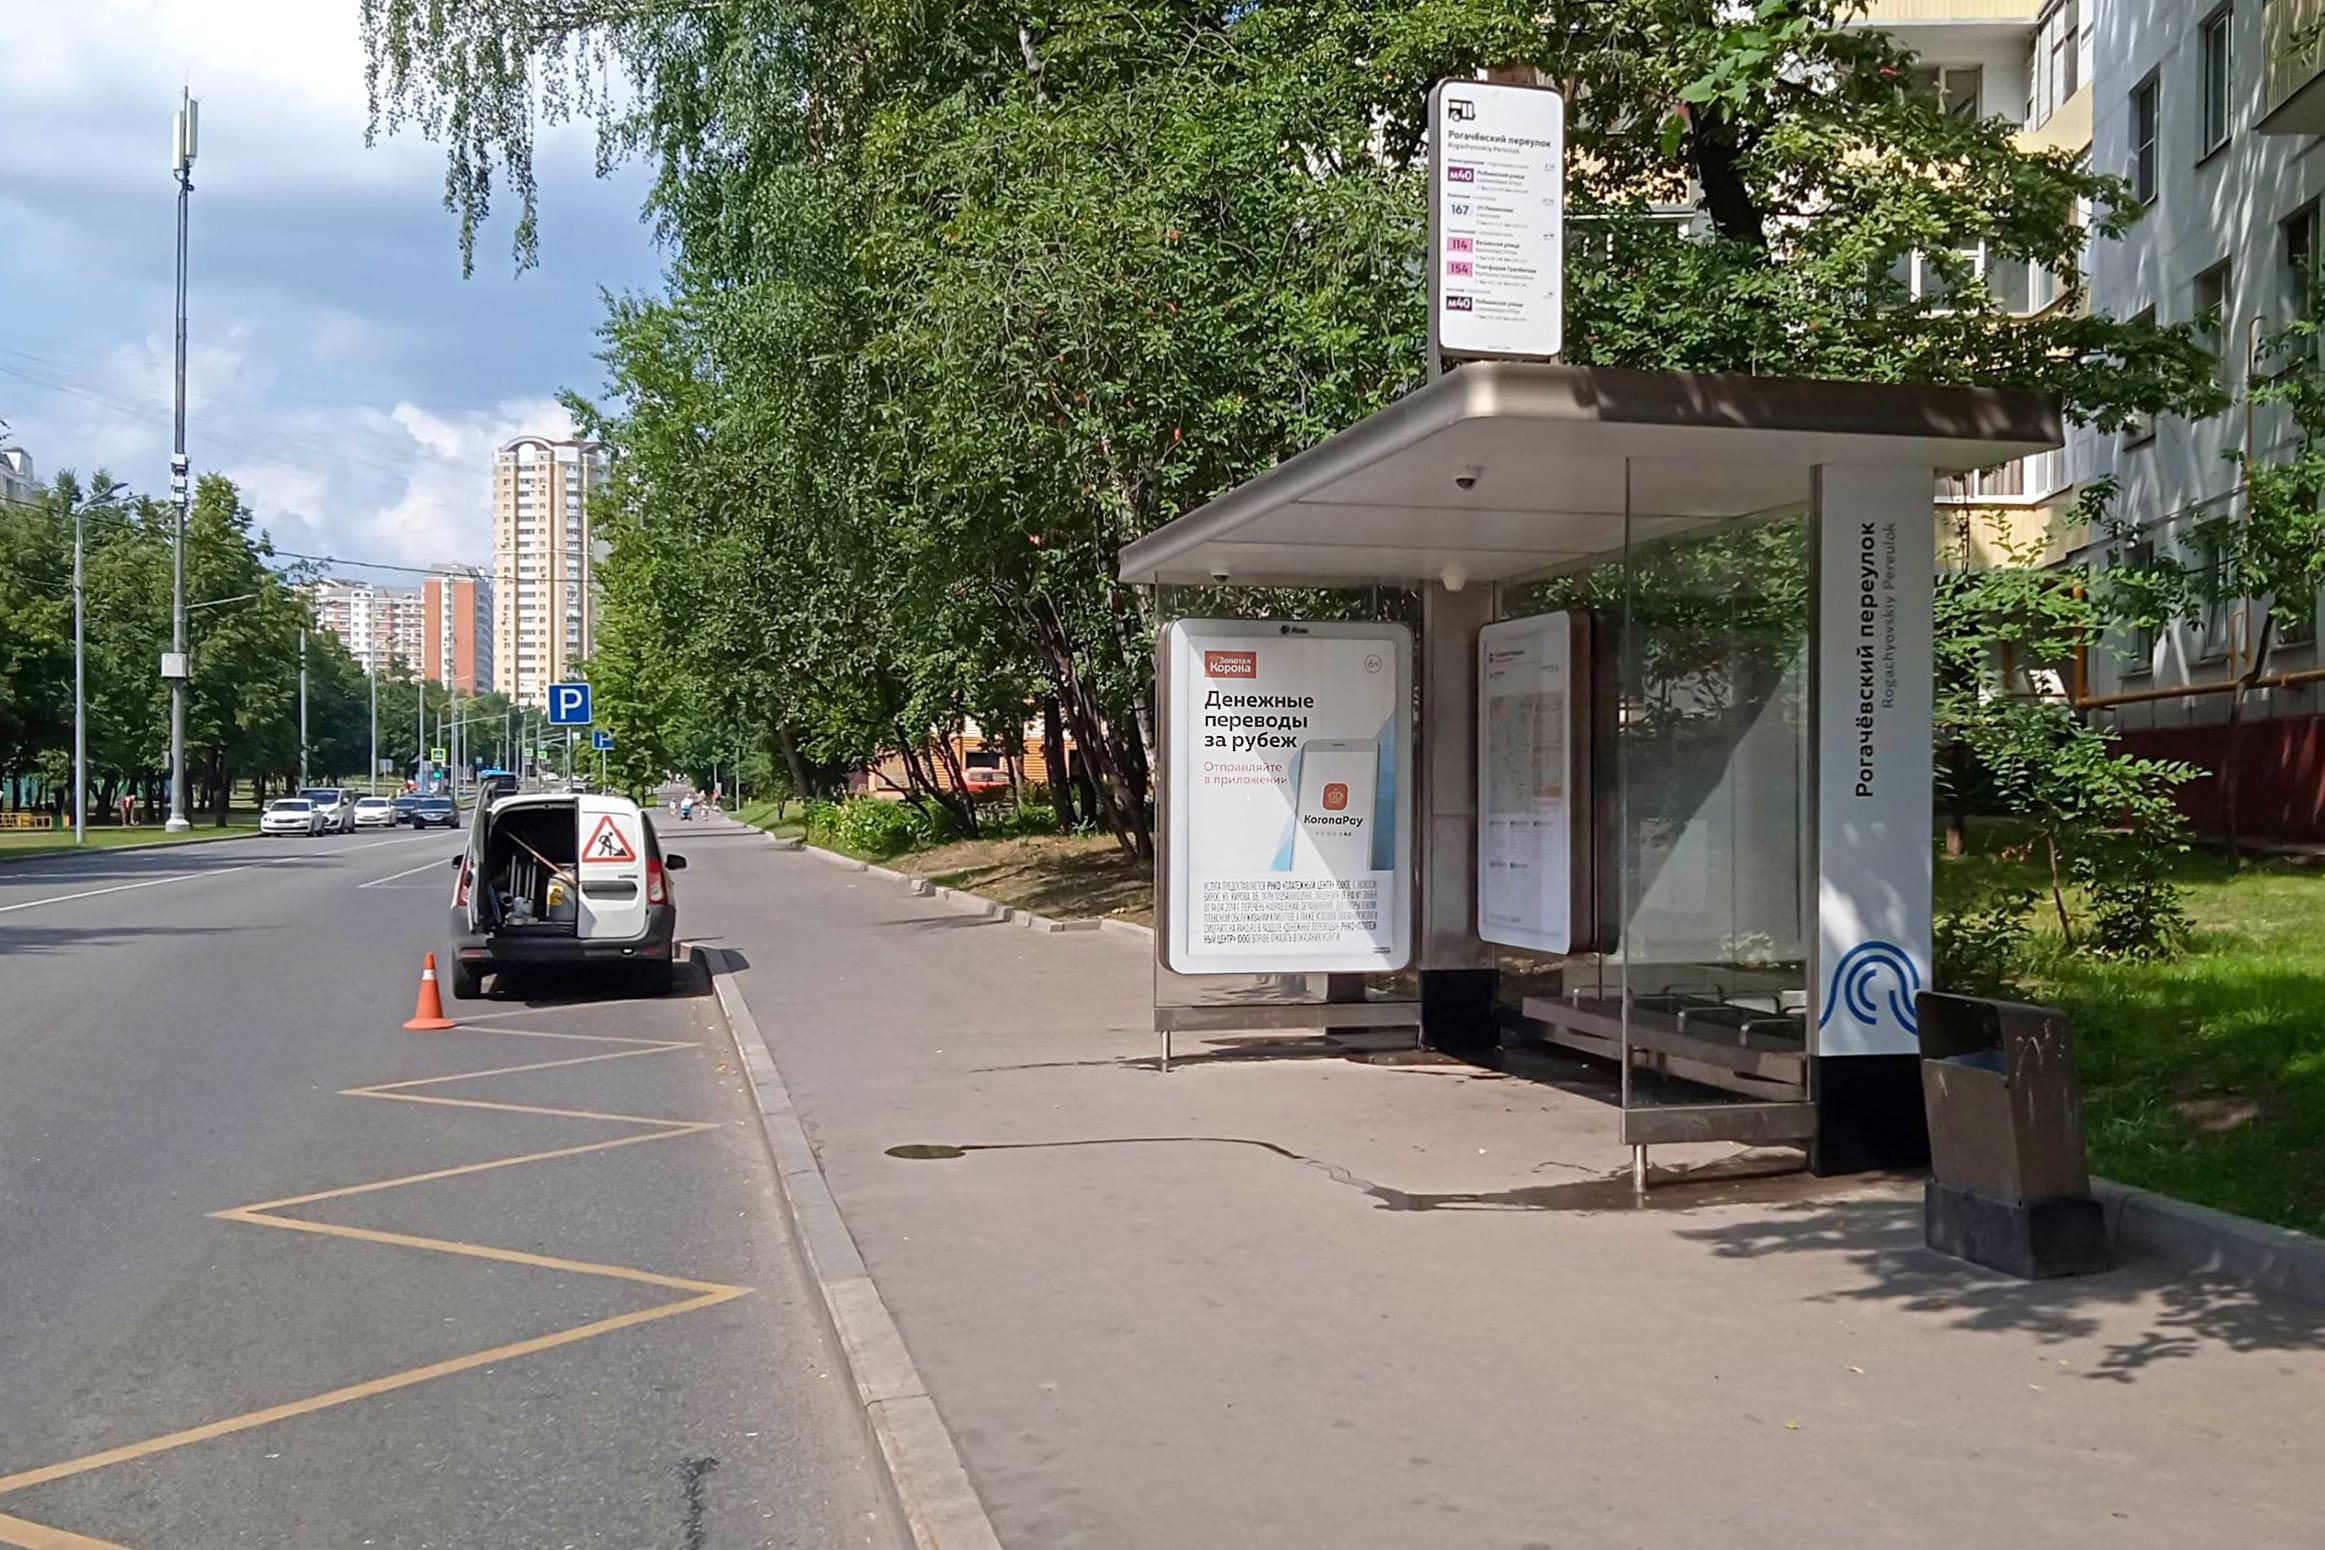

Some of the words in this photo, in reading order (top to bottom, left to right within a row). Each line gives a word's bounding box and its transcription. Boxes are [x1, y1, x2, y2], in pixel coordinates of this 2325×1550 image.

[1508, 137, 1551, 149] переулок
[1449, 169, 1472, 181] м40
[1451, 204, 1470, 216] 167
[1452, 239, 1468, 250] 114
[1450, 263, 1468, 274] 154
[1447, 298, 1471, 310] м40
[1882, 522, 1896, 590] Pereulok
[1861, 521, 1879, 637] переулок
[1882, 595, 1897, 709] Rogachyovskiy
[1218, 656, 1252, 665] Золотая
[1209, 662, 1252, 674] Корона
[559, 688, 583, 720] P
[1204, 690, 1314, 710] Денежные
[1204, 714, 1308, 731] переводы
[1855, 645, 1875, 798] Рогачёвский
[1204, 734, 1227, 747] за
[1232, 732, 1298, 752] рубеж
[1203, 761, 1282, 773] Отправляйте
[1203, 776, 1211, 785] в
[1213, 776, 1289, 787] приложении
[1303, 814, 1364, 828] KoronaPay
